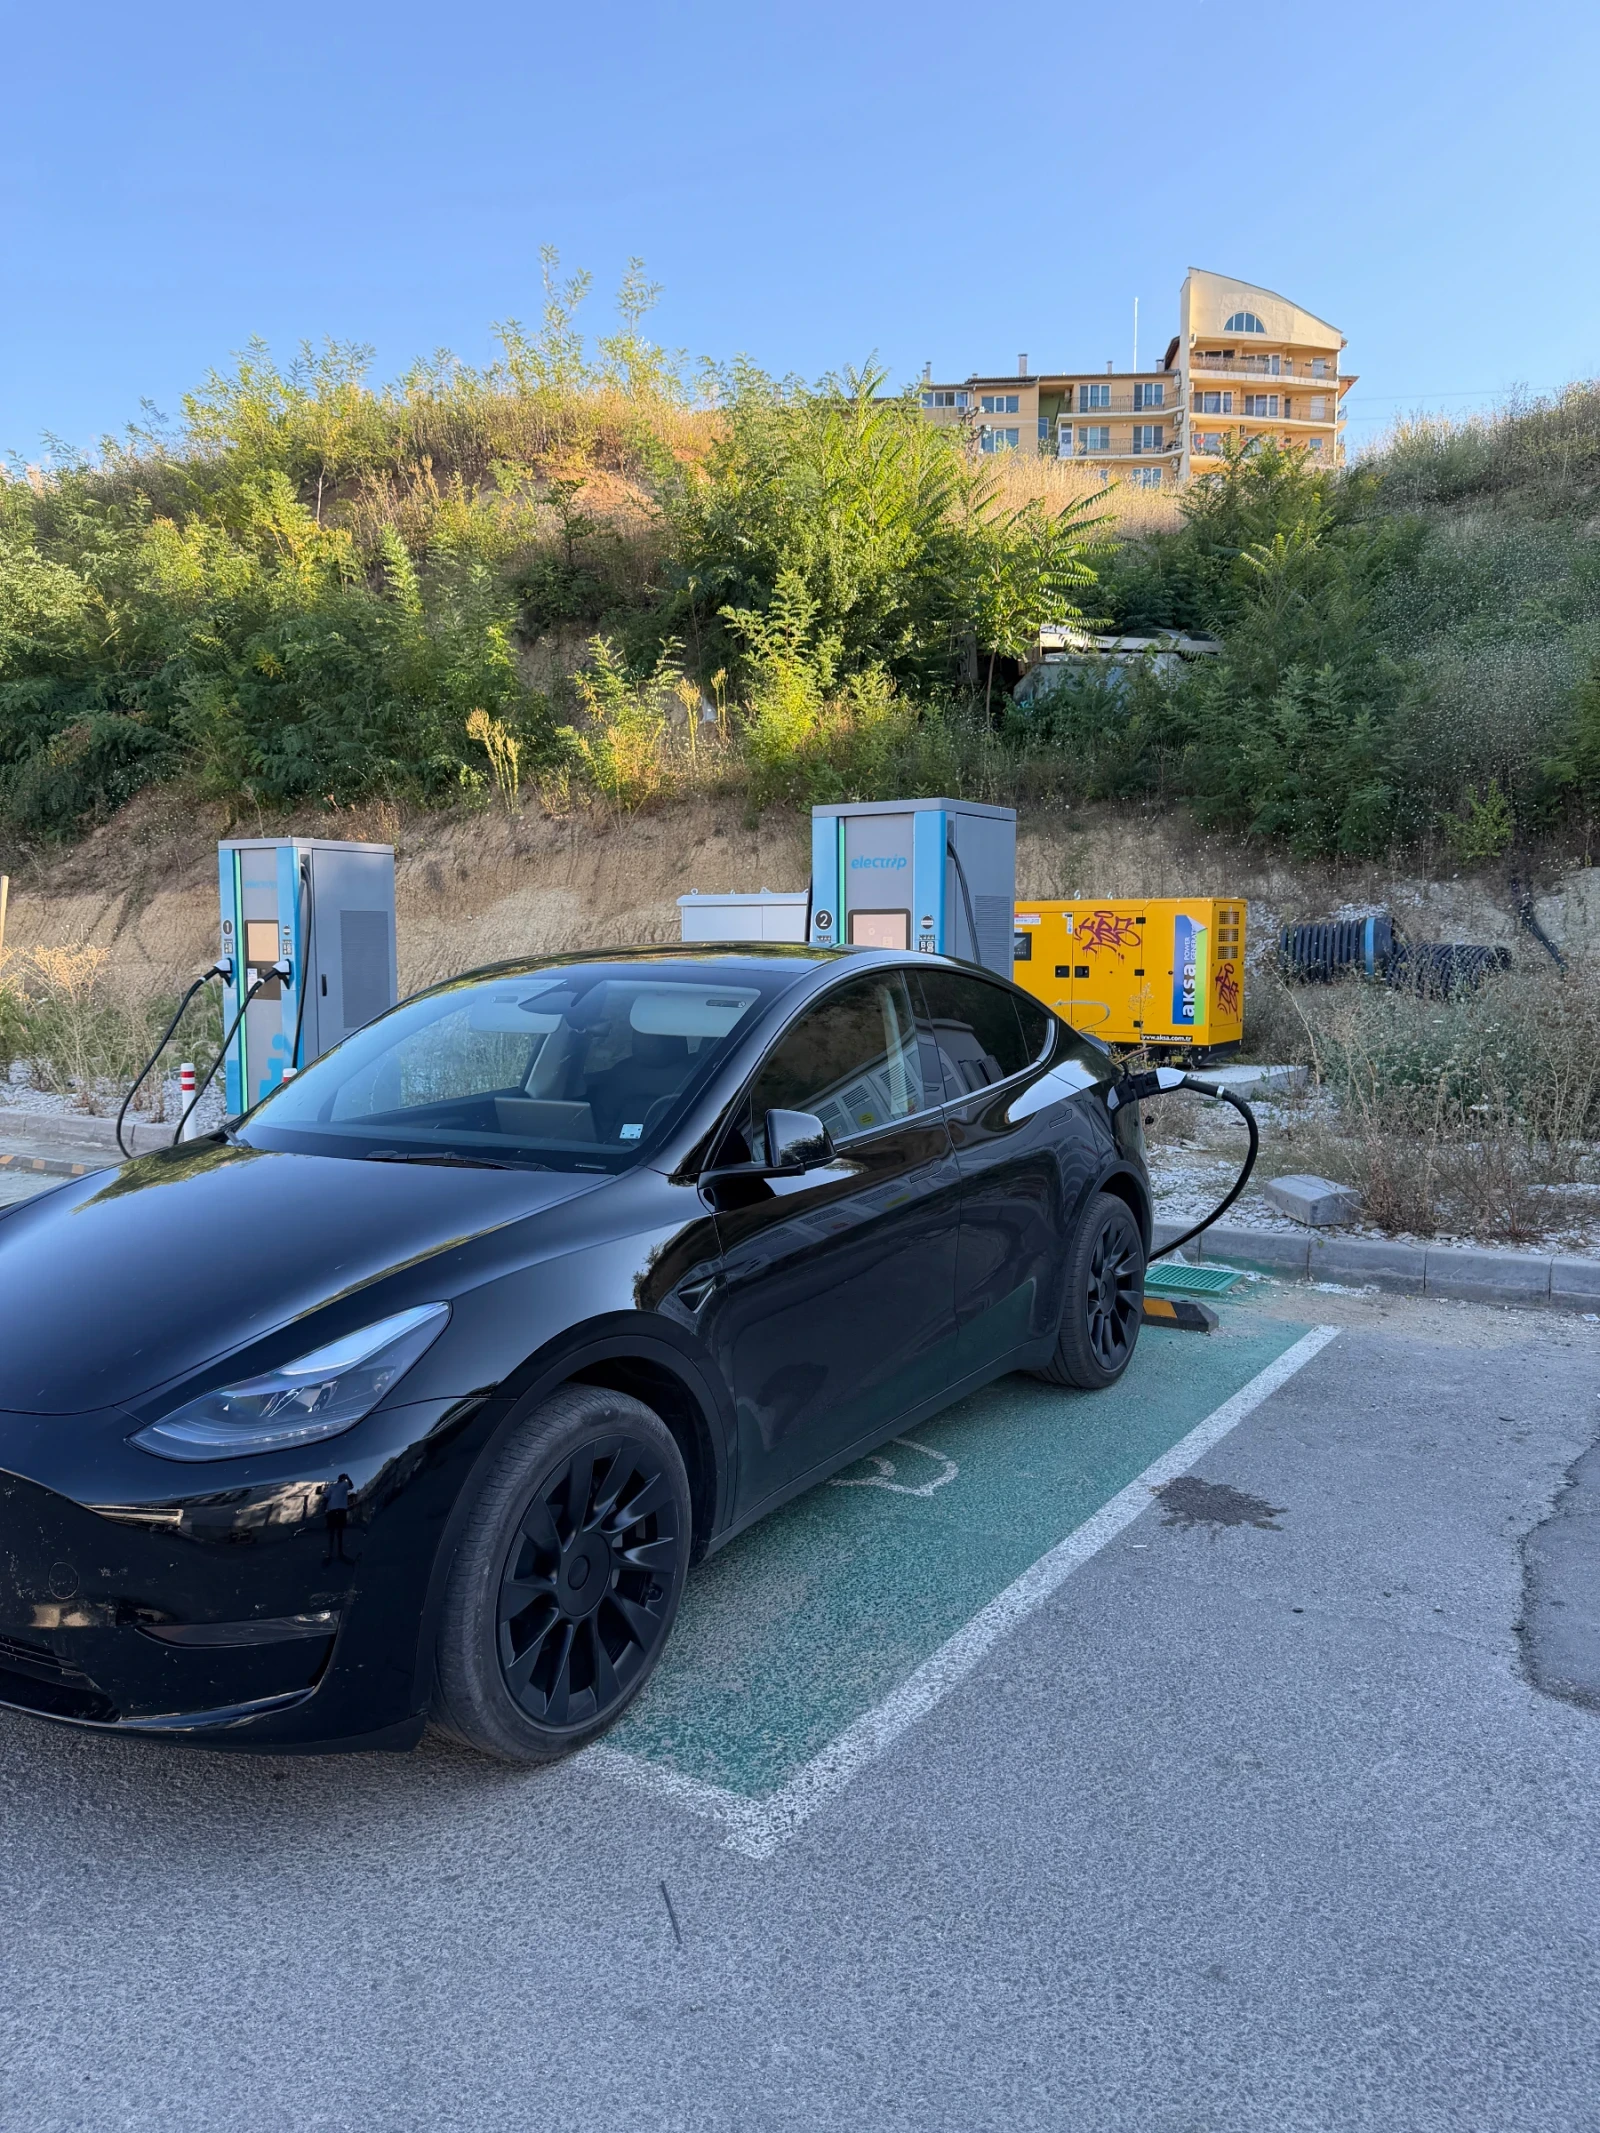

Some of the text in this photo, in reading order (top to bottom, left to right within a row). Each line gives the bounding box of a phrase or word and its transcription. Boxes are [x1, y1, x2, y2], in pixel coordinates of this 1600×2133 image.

[851, 854, 907, 870] electrip
[819, 913, 828, 926] 2
[1183, 964, 1195, 1017] aksa
